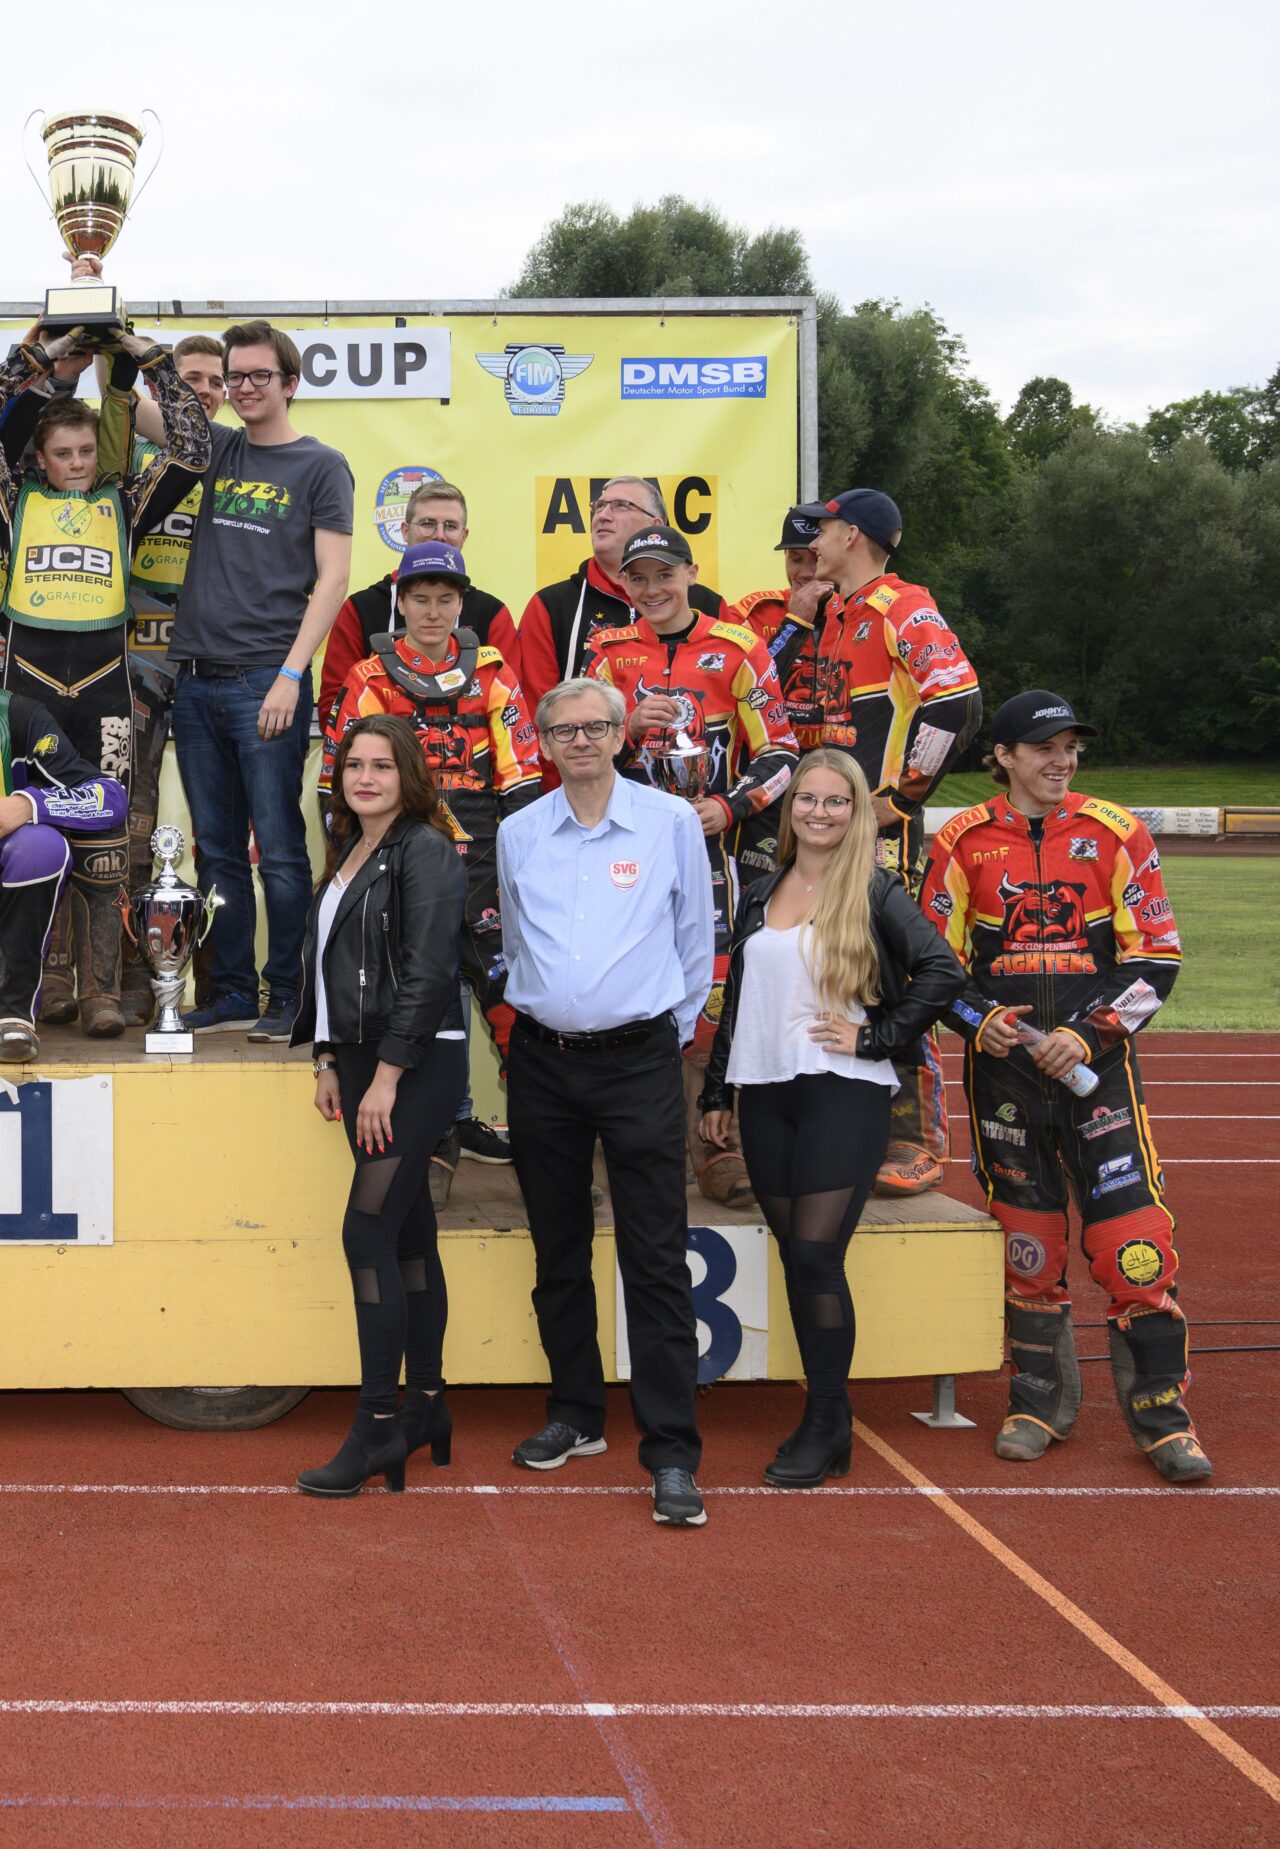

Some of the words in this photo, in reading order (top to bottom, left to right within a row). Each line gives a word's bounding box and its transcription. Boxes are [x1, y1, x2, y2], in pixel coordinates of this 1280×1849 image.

[302, 342, 427, 386] CUP
[516, 362, 553, 386] FIM
[623, 362, 765, 385] DMSB
[623, 386, 665, 396] Deutscher
[668, 386, 694, 395] Motor
[696, 385, 720, 397] Sport
[723, 384, 746, 393] Bund
[517, 405, 553, 415] EUROPE
[97, 505, 112, 518] 11
[628, 537, 669, 552] ellesse
[27, 546, 111, 574] JCB
[25, 573, 113, 588] STERNBERG
[46, 591, 104, 605] GRAFICIO
[726, 627, 754, 647] DEKRA
[1100, 806, 1131, 832] DEKRA
[613, 862, 638, 877] SVG
[1123, 891, 1146, 909] PRO
[1010, 942, 1025, 951] MSC
[1025, 941, 1078, 951] CLOPPENBURG
[990, 952, 1098, 975] FIGHTERS
